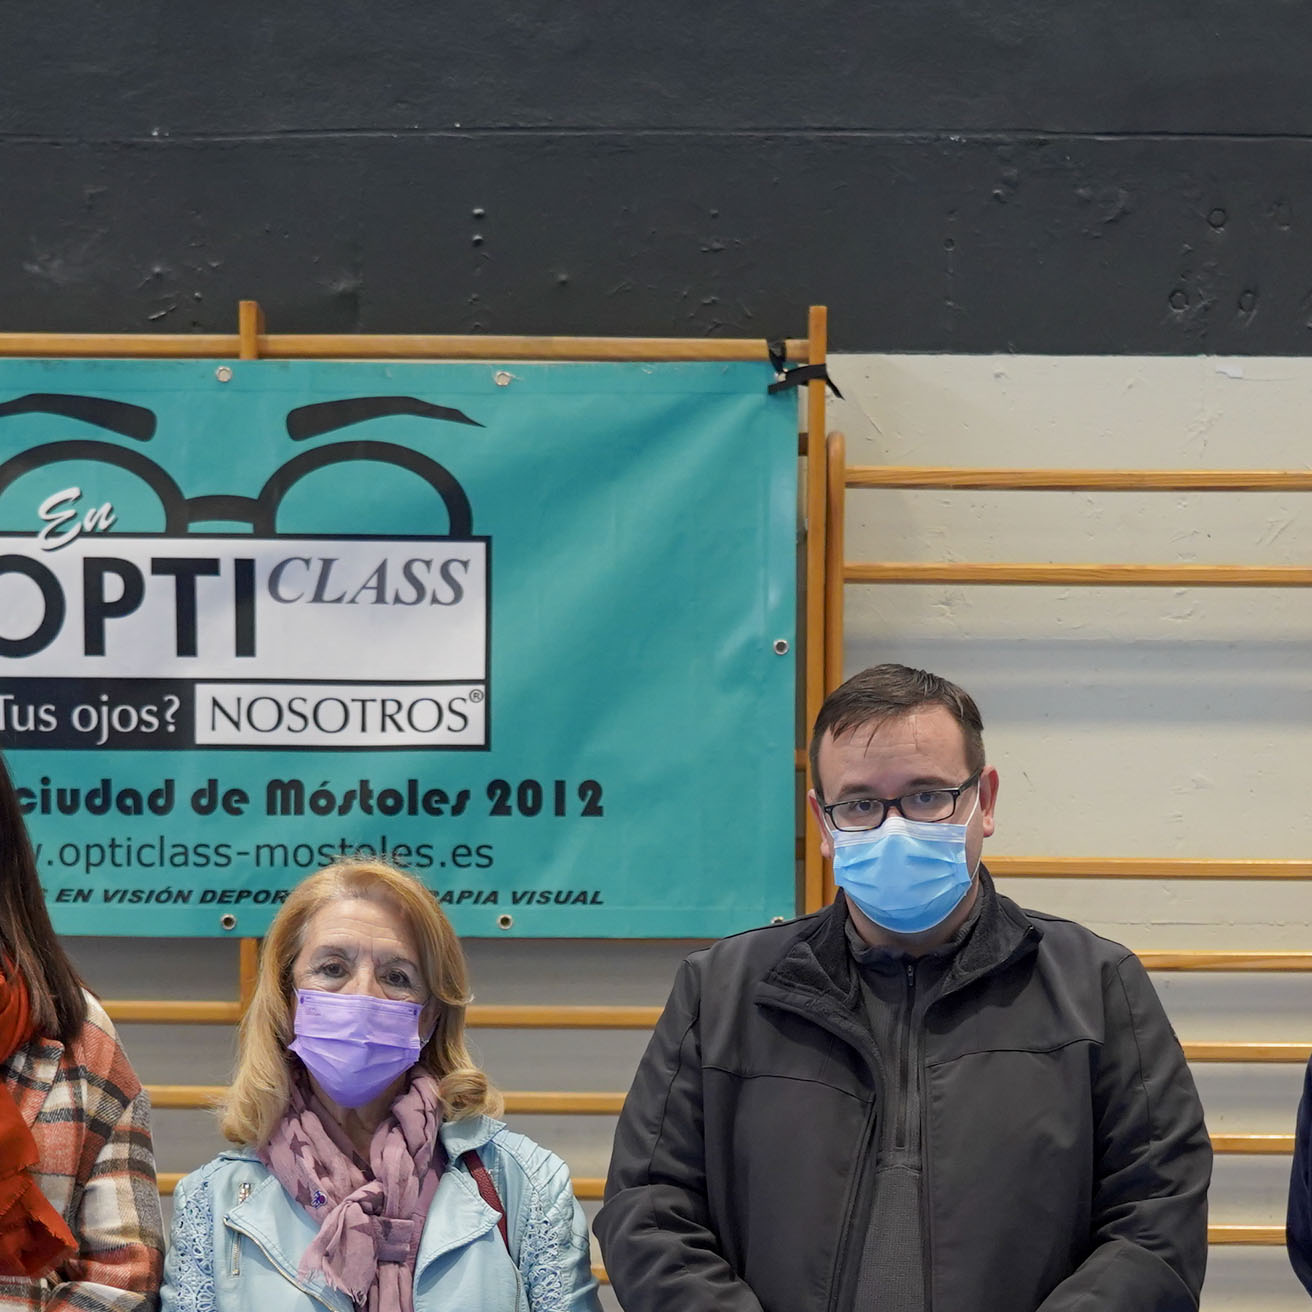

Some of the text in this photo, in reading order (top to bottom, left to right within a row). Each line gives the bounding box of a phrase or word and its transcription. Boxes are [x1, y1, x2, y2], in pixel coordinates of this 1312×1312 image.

[37, 486, 117, 551] En
[71, 694, 181, 745] ojos?
[16, 776, 604, 817] ciudad de Móstoles 2012
[35, 835, 494, 875] .opticlass-mostoles.es
[55, 888, 94, 903] EN
[103, 885, 193, 904] VISIÓN
[199, 889, 290, 904] DEPOR
[511, 890, 604, 905] VISUAL
